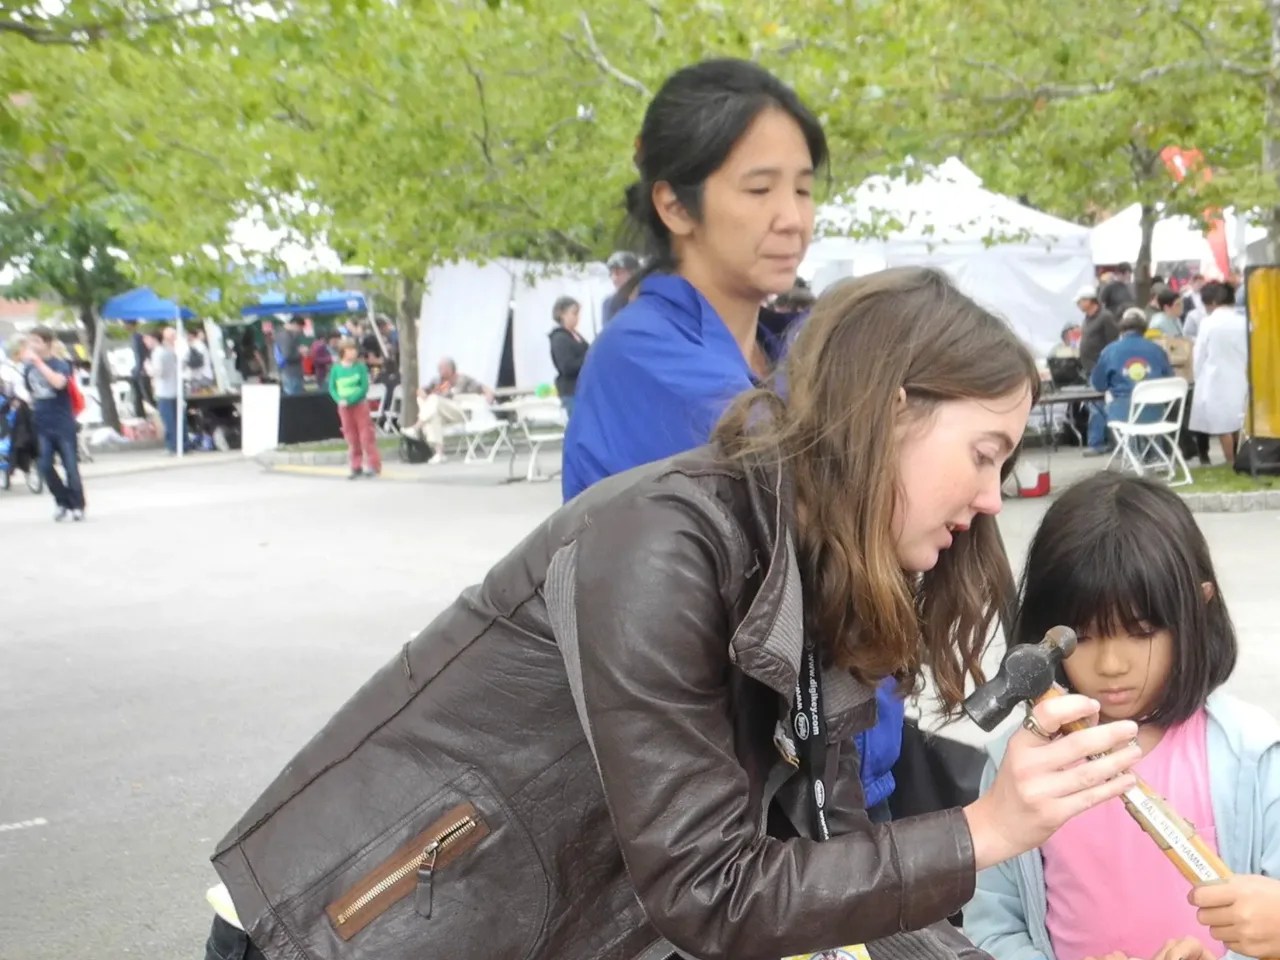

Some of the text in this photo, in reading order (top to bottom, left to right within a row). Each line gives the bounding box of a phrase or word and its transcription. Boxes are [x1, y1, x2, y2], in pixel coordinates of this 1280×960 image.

[808, 653, 821, 736] www.digikey.com
[1160, 819, 1180, 845] PEEN
[1180, 842, 1212, 879] HAMMER
